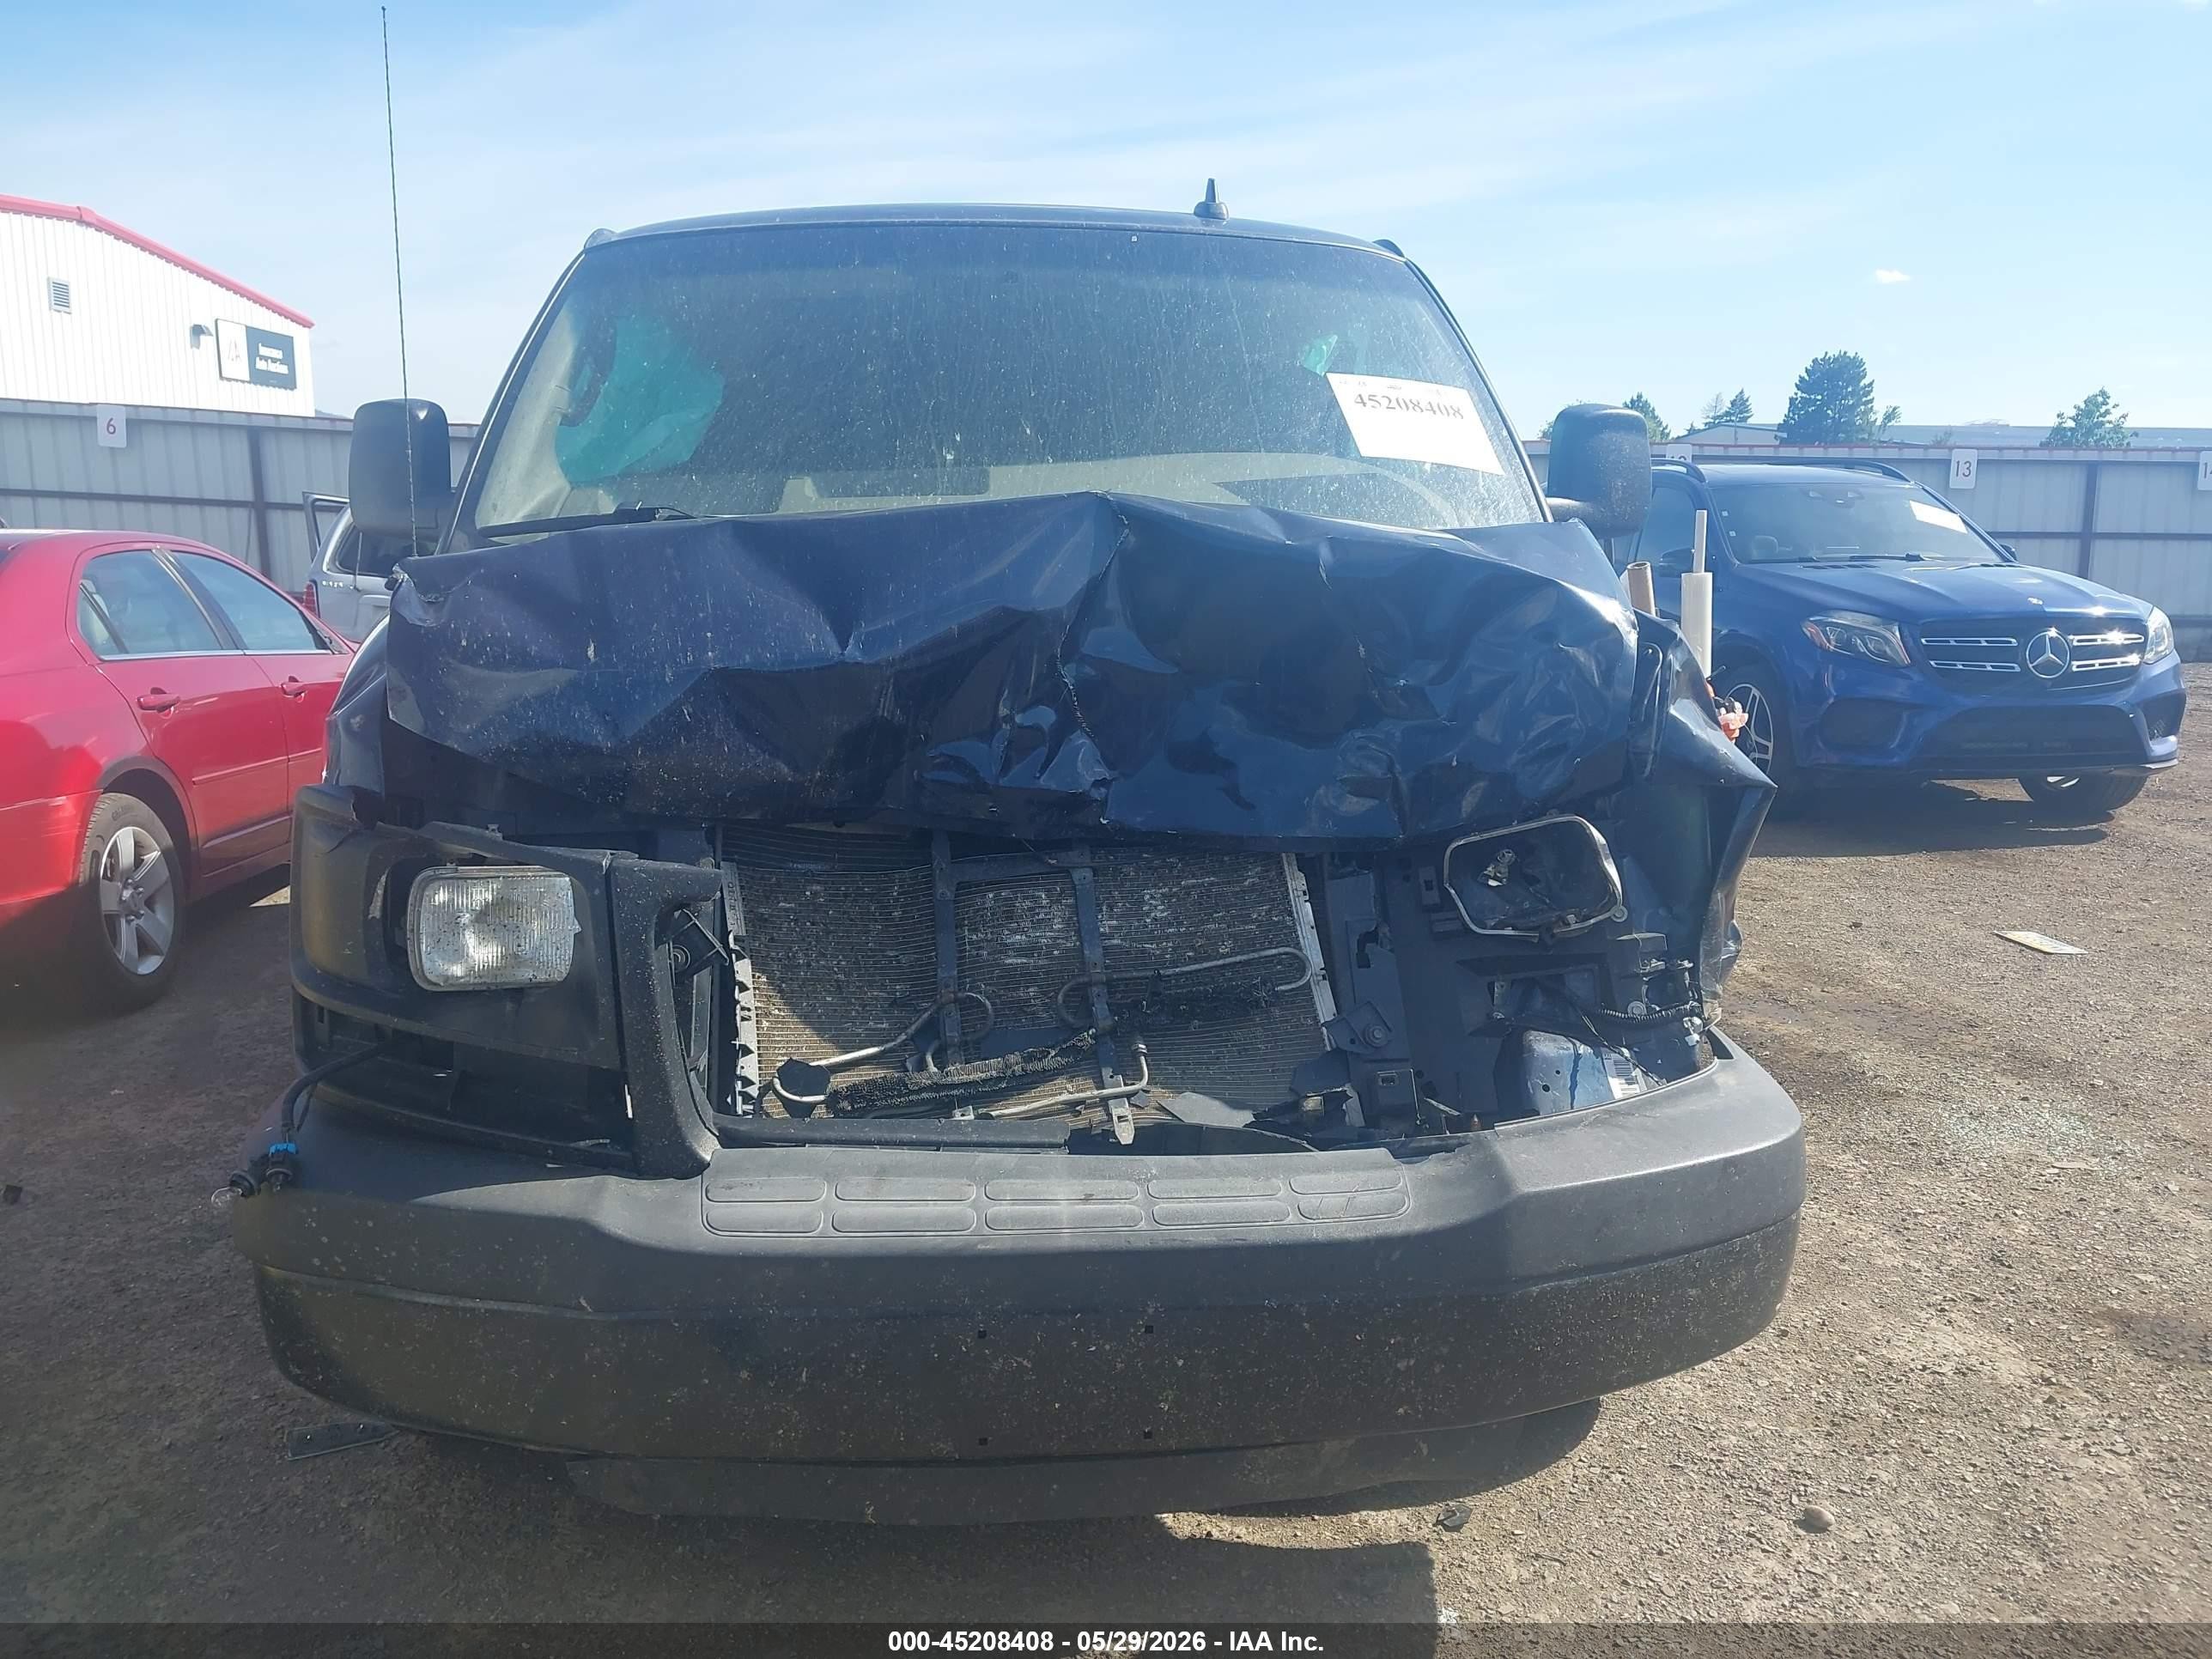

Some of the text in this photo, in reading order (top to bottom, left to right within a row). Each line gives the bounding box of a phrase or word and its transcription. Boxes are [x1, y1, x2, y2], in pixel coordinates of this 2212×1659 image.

[1353, 392, 1465, 419] 45208408
[106, 416, 117, 435] 6
[1955, 459, 1972, 477] 13
